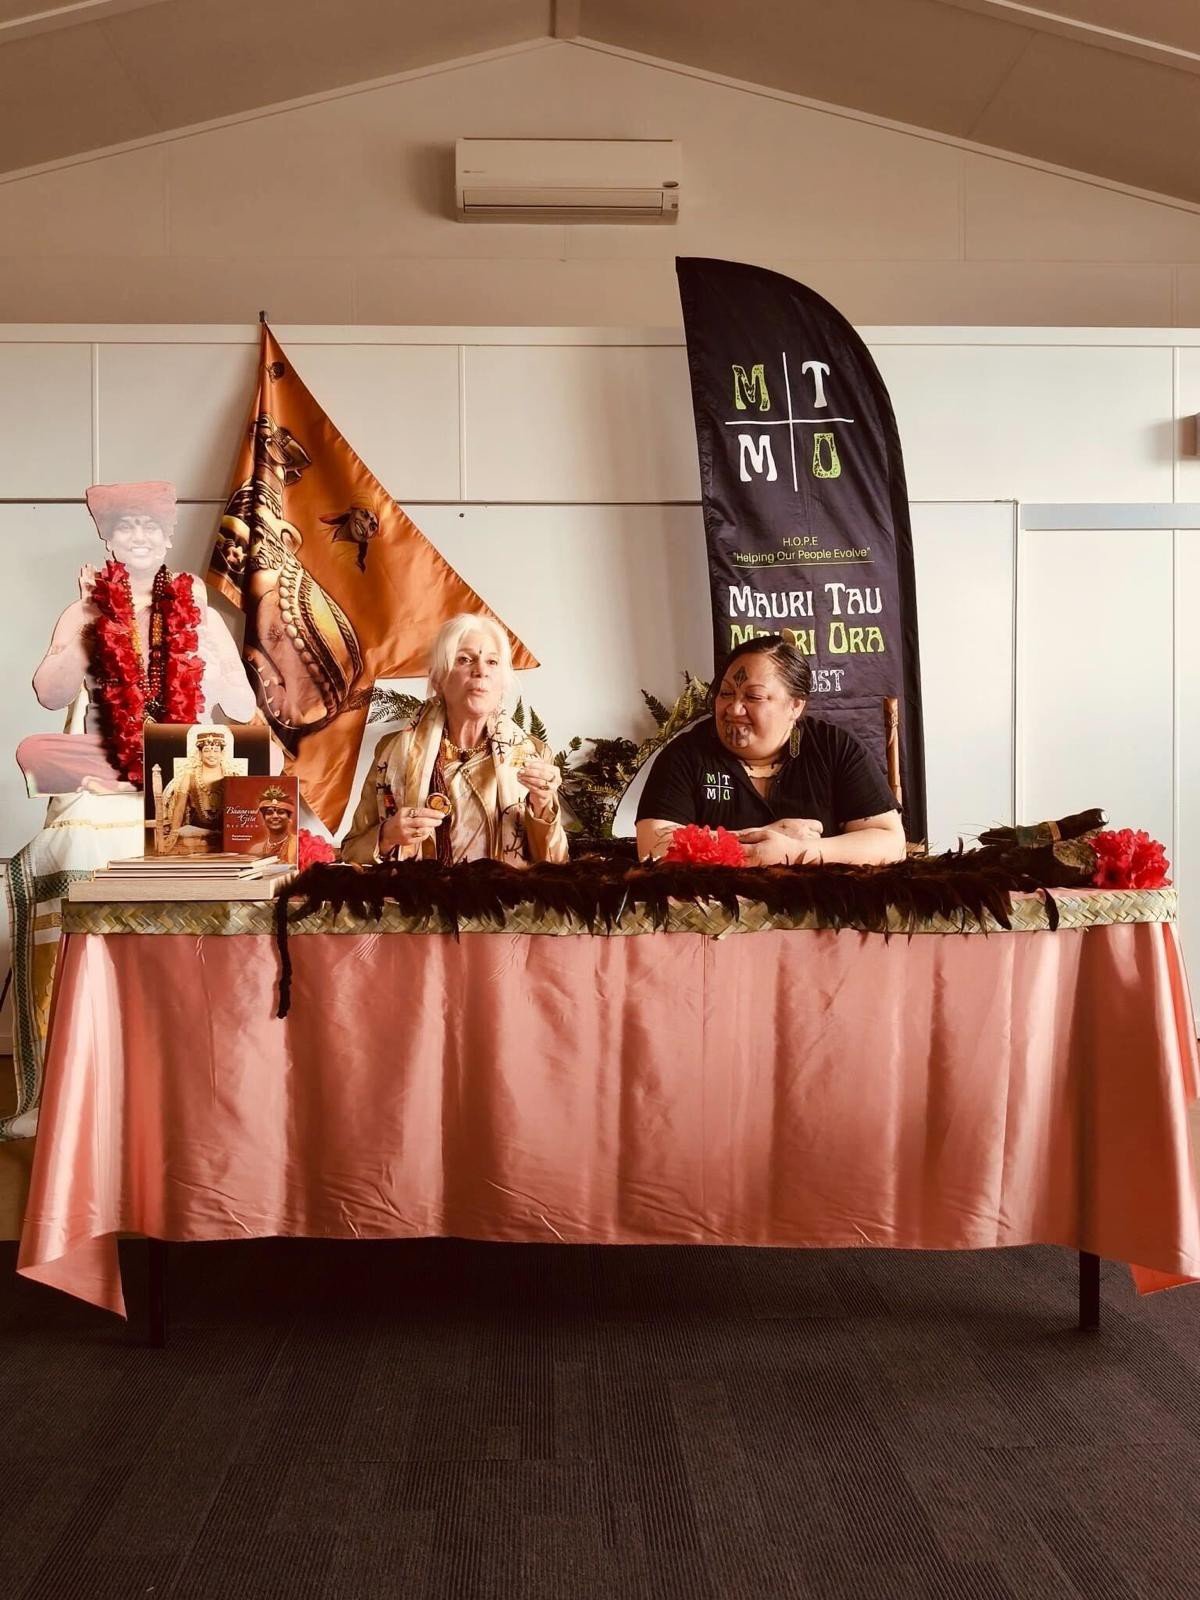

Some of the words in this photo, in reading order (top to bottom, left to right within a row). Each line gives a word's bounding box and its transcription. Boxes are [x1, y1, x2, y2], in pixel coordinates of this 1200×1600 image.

[731, 363, 771, 412] M
[801, 360, 831, 409] T
[737, 433, 778, 482] M
[777, 551, 796, 561] Our
[798, 549, 832, 560] People
[783, 536, 819, 546] H.O.P.E
[728, 585, 814, 618] MAURI
[824, 582, 883, 615] TAU
[730, 624, 817, 655] MRI
[828, 622, 885, 654] ORA
[722, 774, 730, 785] T
